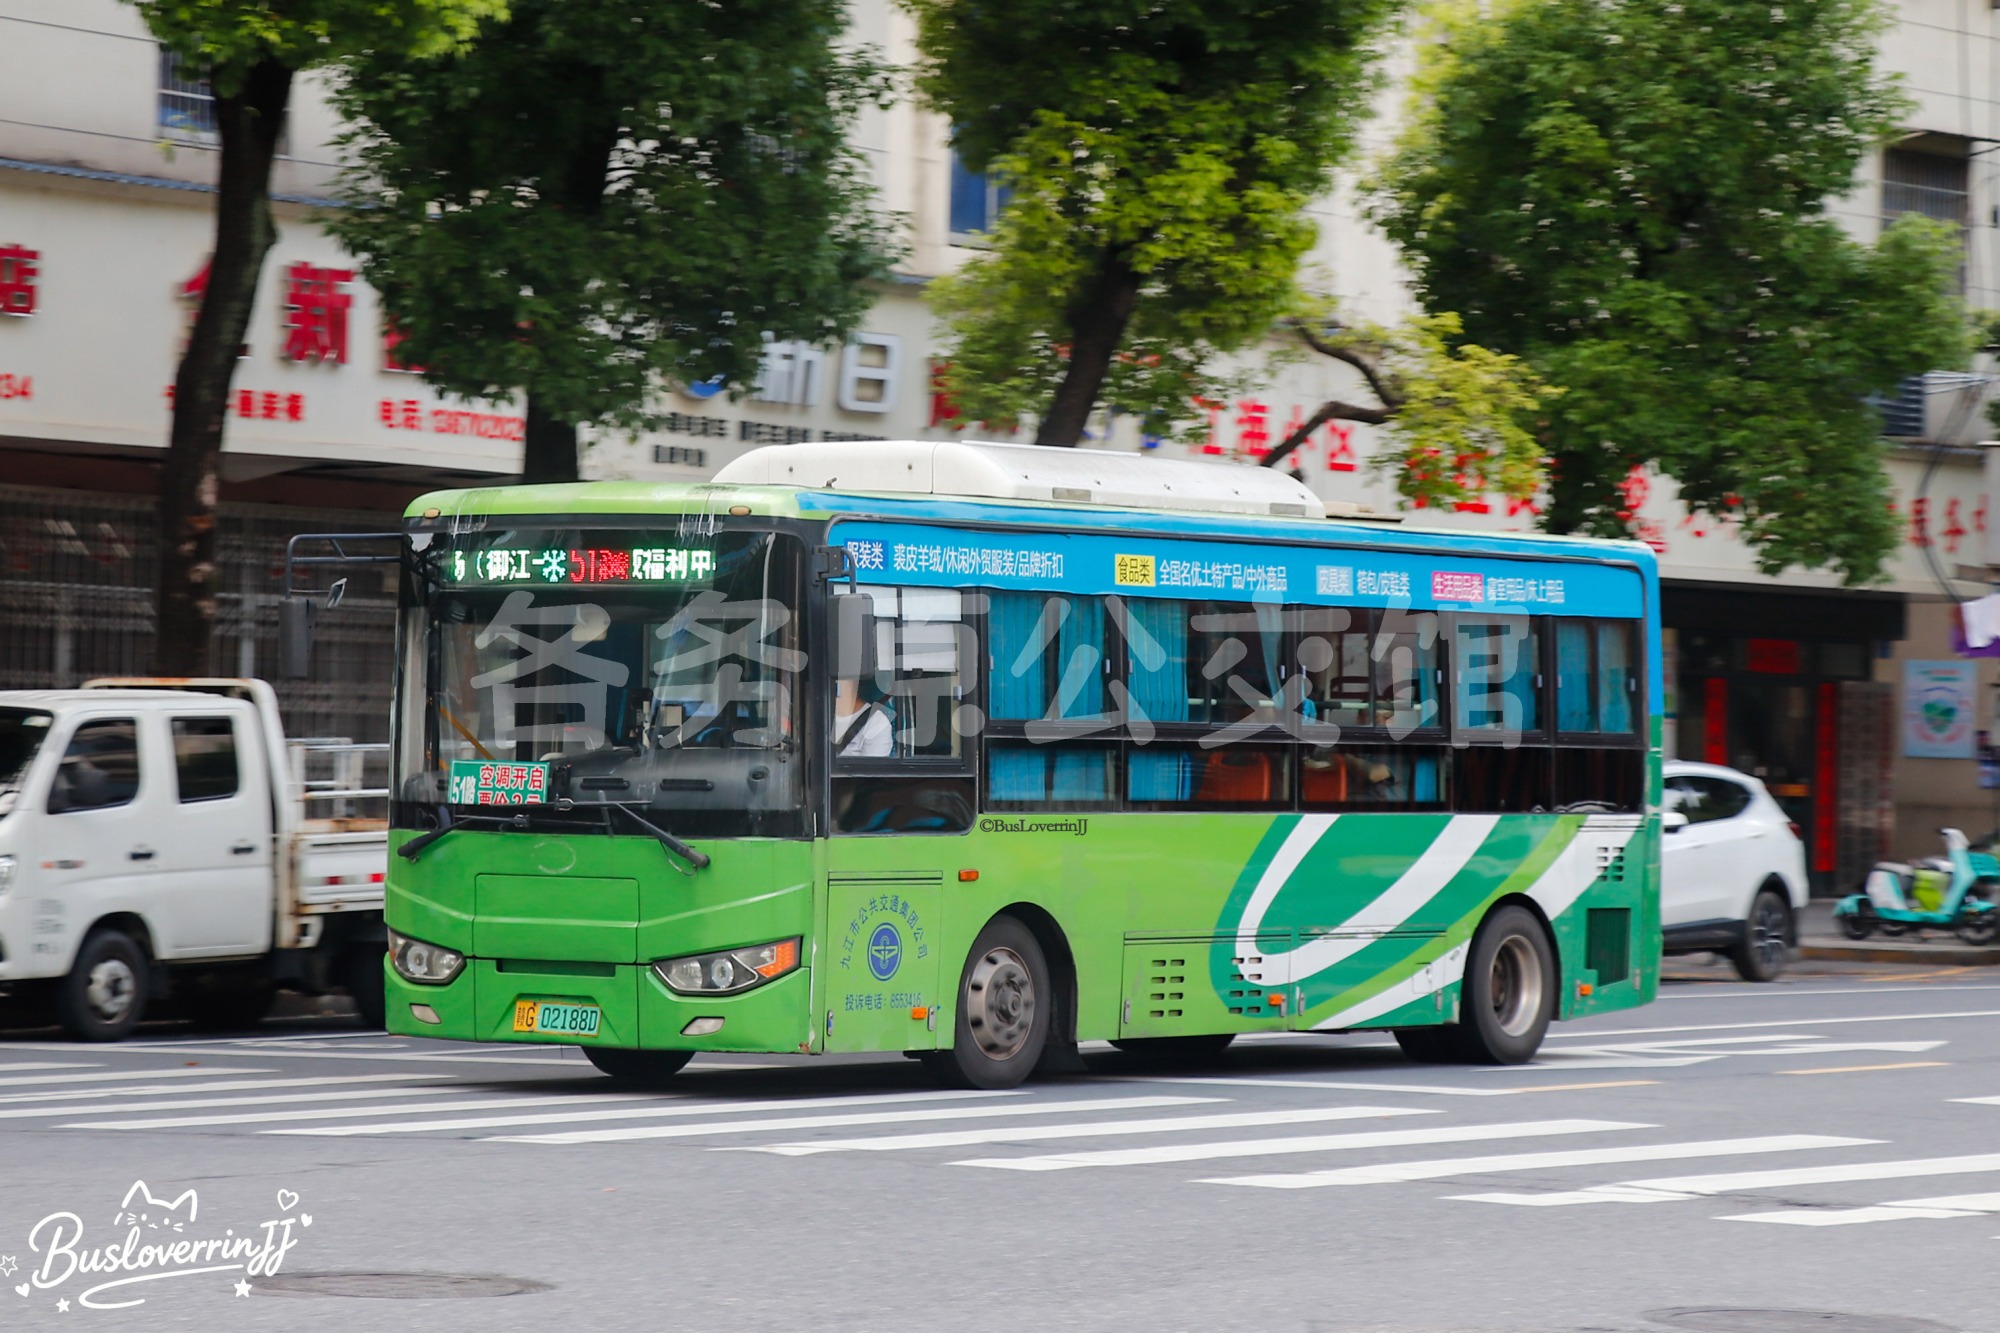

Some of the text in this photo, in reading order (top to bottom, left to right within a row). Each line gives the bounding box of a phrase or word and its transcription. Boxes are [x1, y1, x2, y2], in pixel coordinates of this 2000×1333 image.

[846, 541, 883, 570] 服装类
[1118, 556, 1151, 584] 食品类
[1159, 559, 1288, 592] 全国名优土特产品/中外商品
[479, 764, 545, 792] 空调开启
[840, 894, 928, 970] 九江市公共交通集团公司
